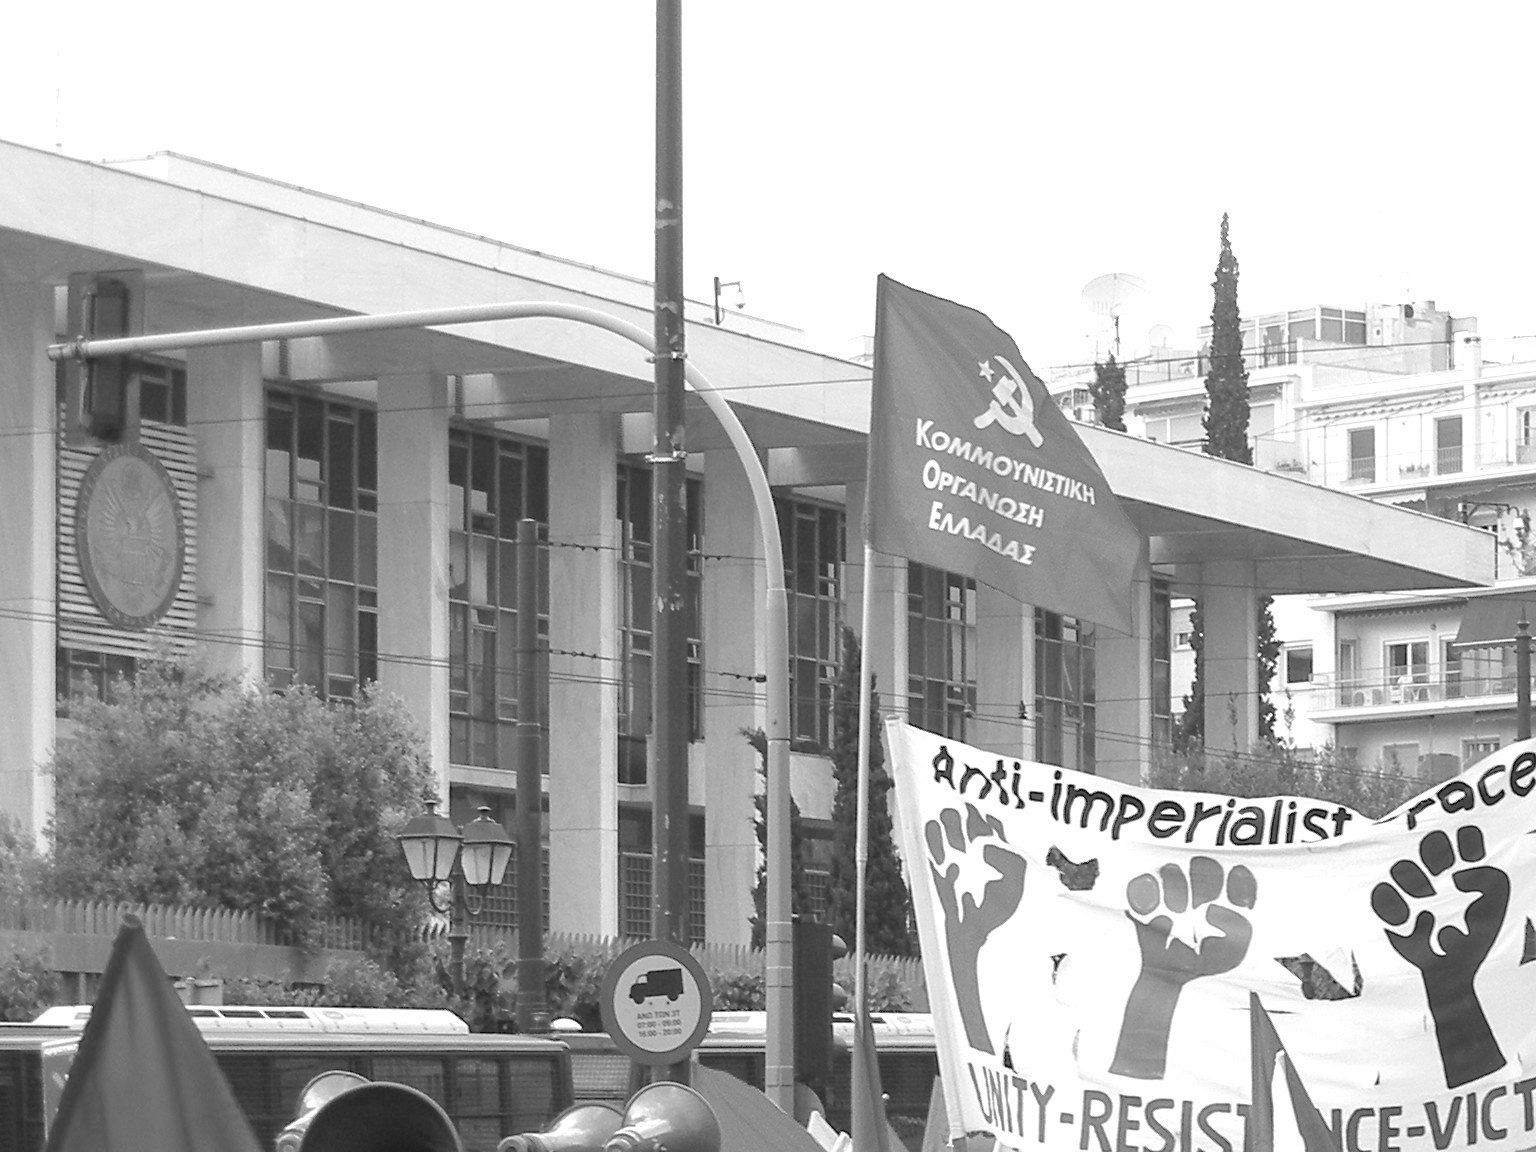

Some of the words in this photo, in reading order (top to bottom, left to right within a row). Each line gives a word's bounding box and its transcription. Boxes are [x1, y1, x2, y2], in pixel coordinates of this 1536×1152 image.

[915, 417, 1097, 506] ΚΟΜΜΟΥΝΙΣΤΙΚΗ
[921, 459, 1045, 529] ΟΡΓΑΝΩΣΗ
[928, 500, 1038, 566] ΕΛΛΑΔΑΣ
